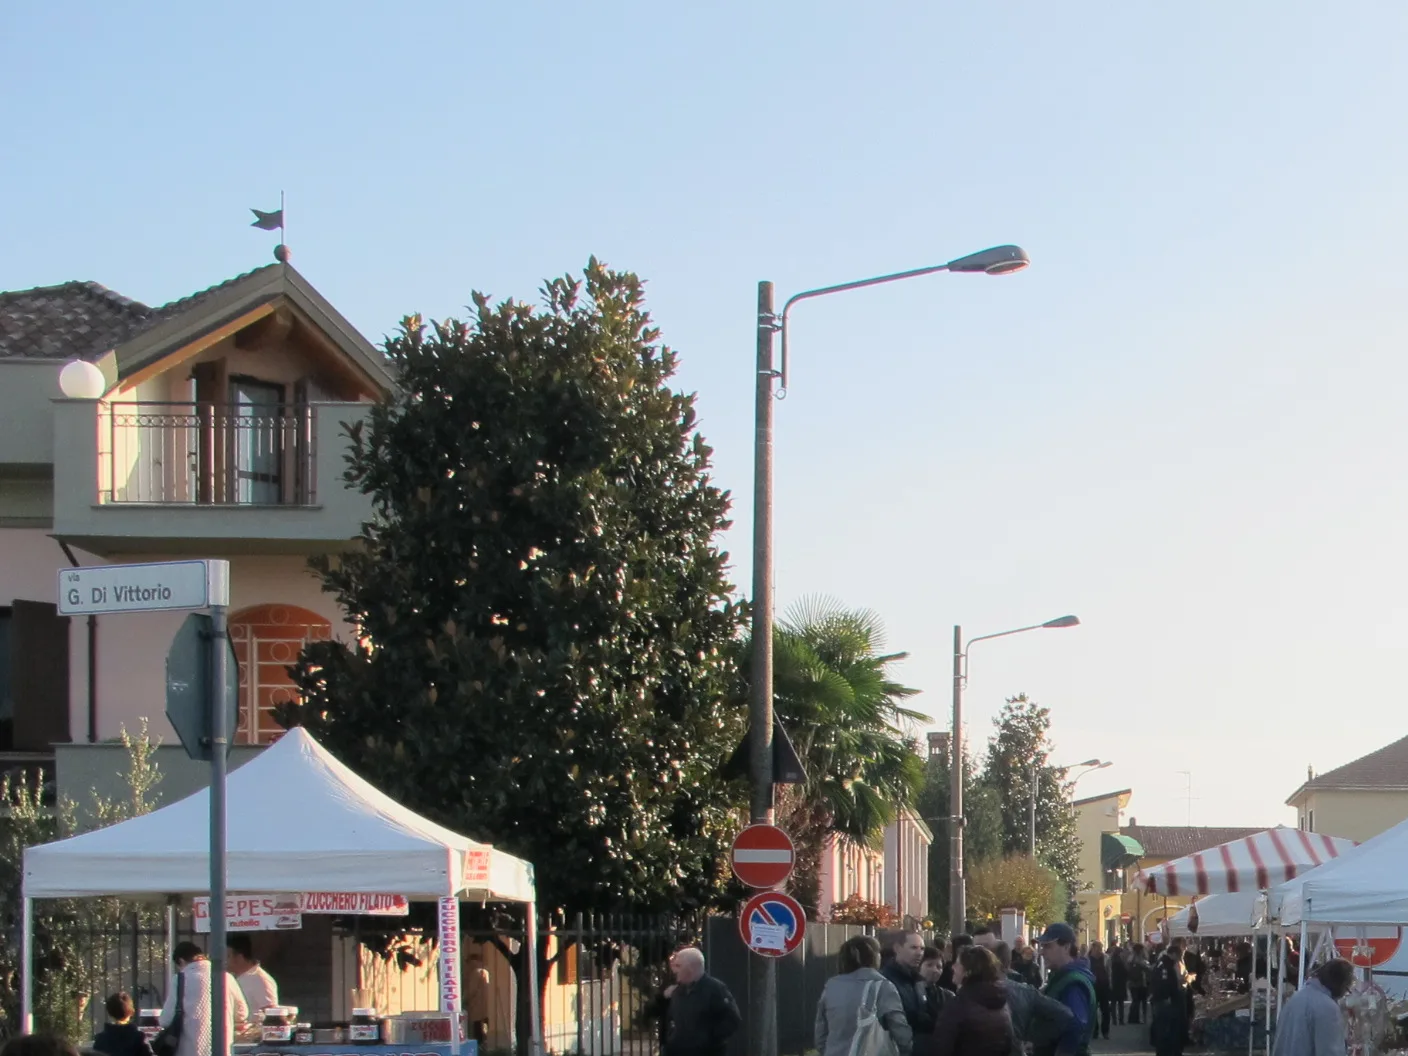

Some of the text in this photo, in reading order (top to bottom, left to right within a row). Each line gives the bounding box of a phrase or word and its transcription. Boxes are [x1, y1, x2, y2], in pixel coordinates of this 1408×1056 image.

[67, 572, 80, 582] via
[67, 583, 171, 606] G. Di Vittorio
[192, 899, 274, 919] CEPES
[306, 892, 393, 911] ZUCCHERO FILATO
[229, 918, 260, 927] nutella
[441, 897, 458, 1000] ZUCCHERO FILATO
